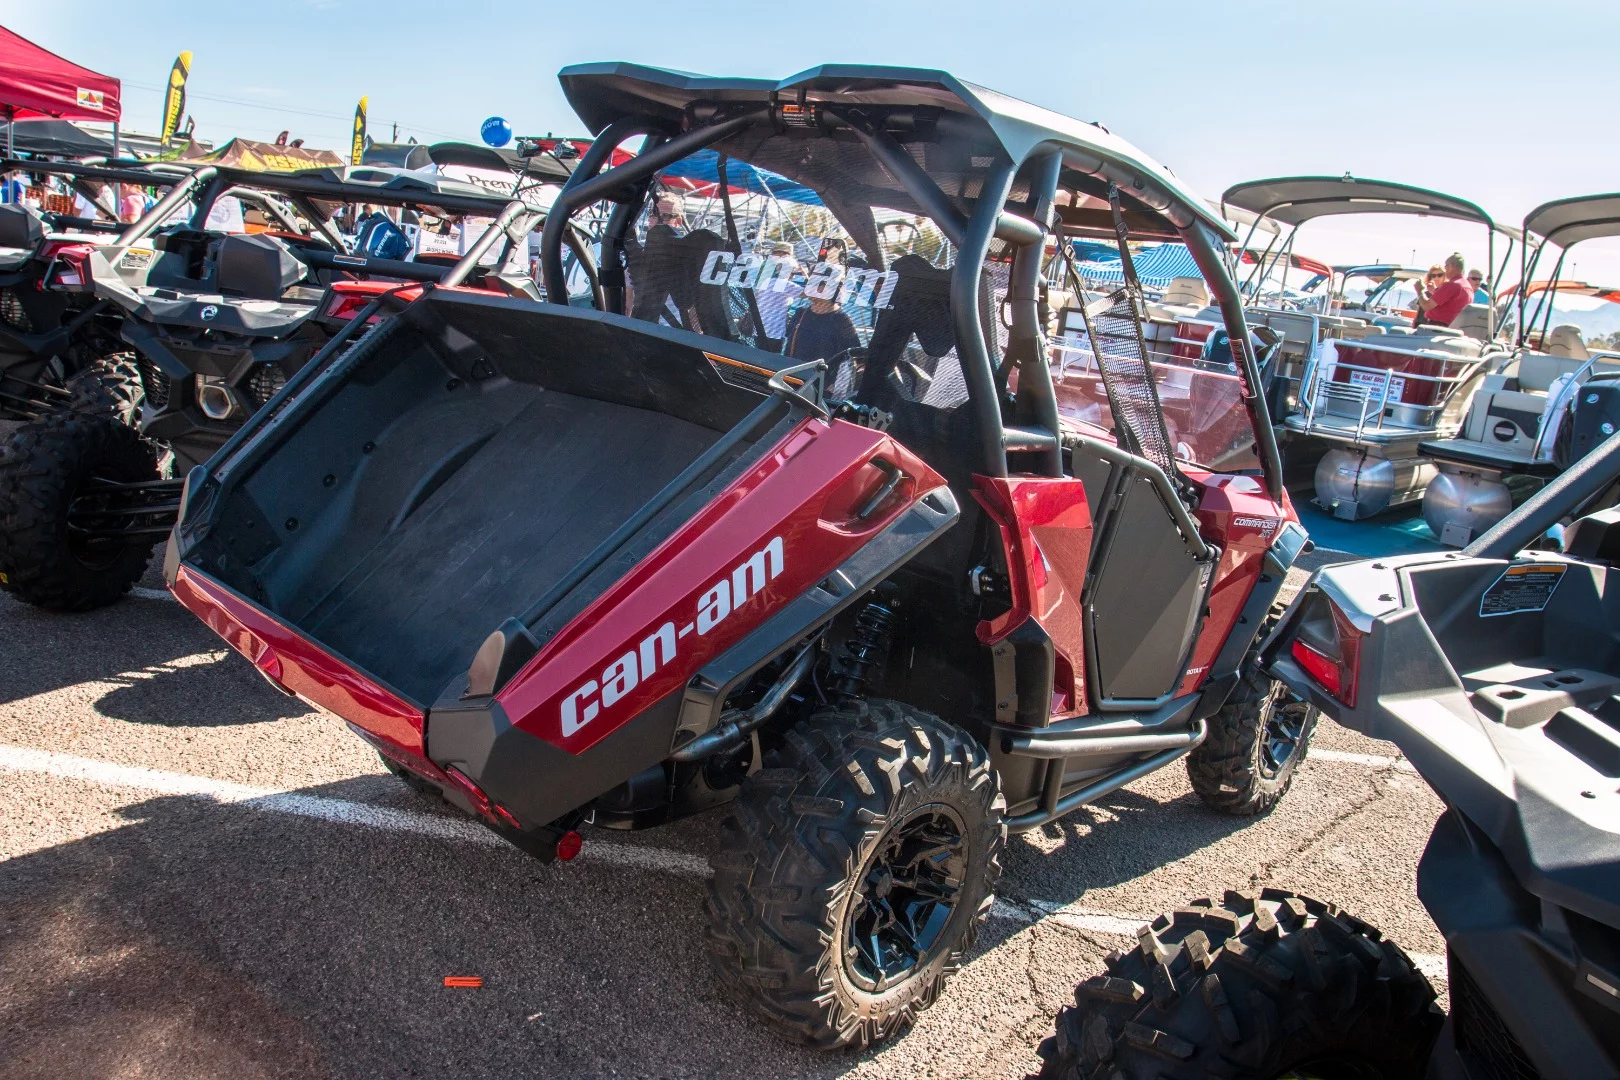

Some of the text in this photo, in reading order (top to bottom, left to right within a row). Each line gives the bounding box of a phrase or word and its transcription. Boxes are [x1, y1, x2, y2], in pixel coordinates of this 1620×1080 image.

[465, 173, 542, 195] Premr
[699, 250, 899, 309] can-am
[1233, 517, 1278, 529] COMMANDER
[560, 536, 784, 738] can-am
